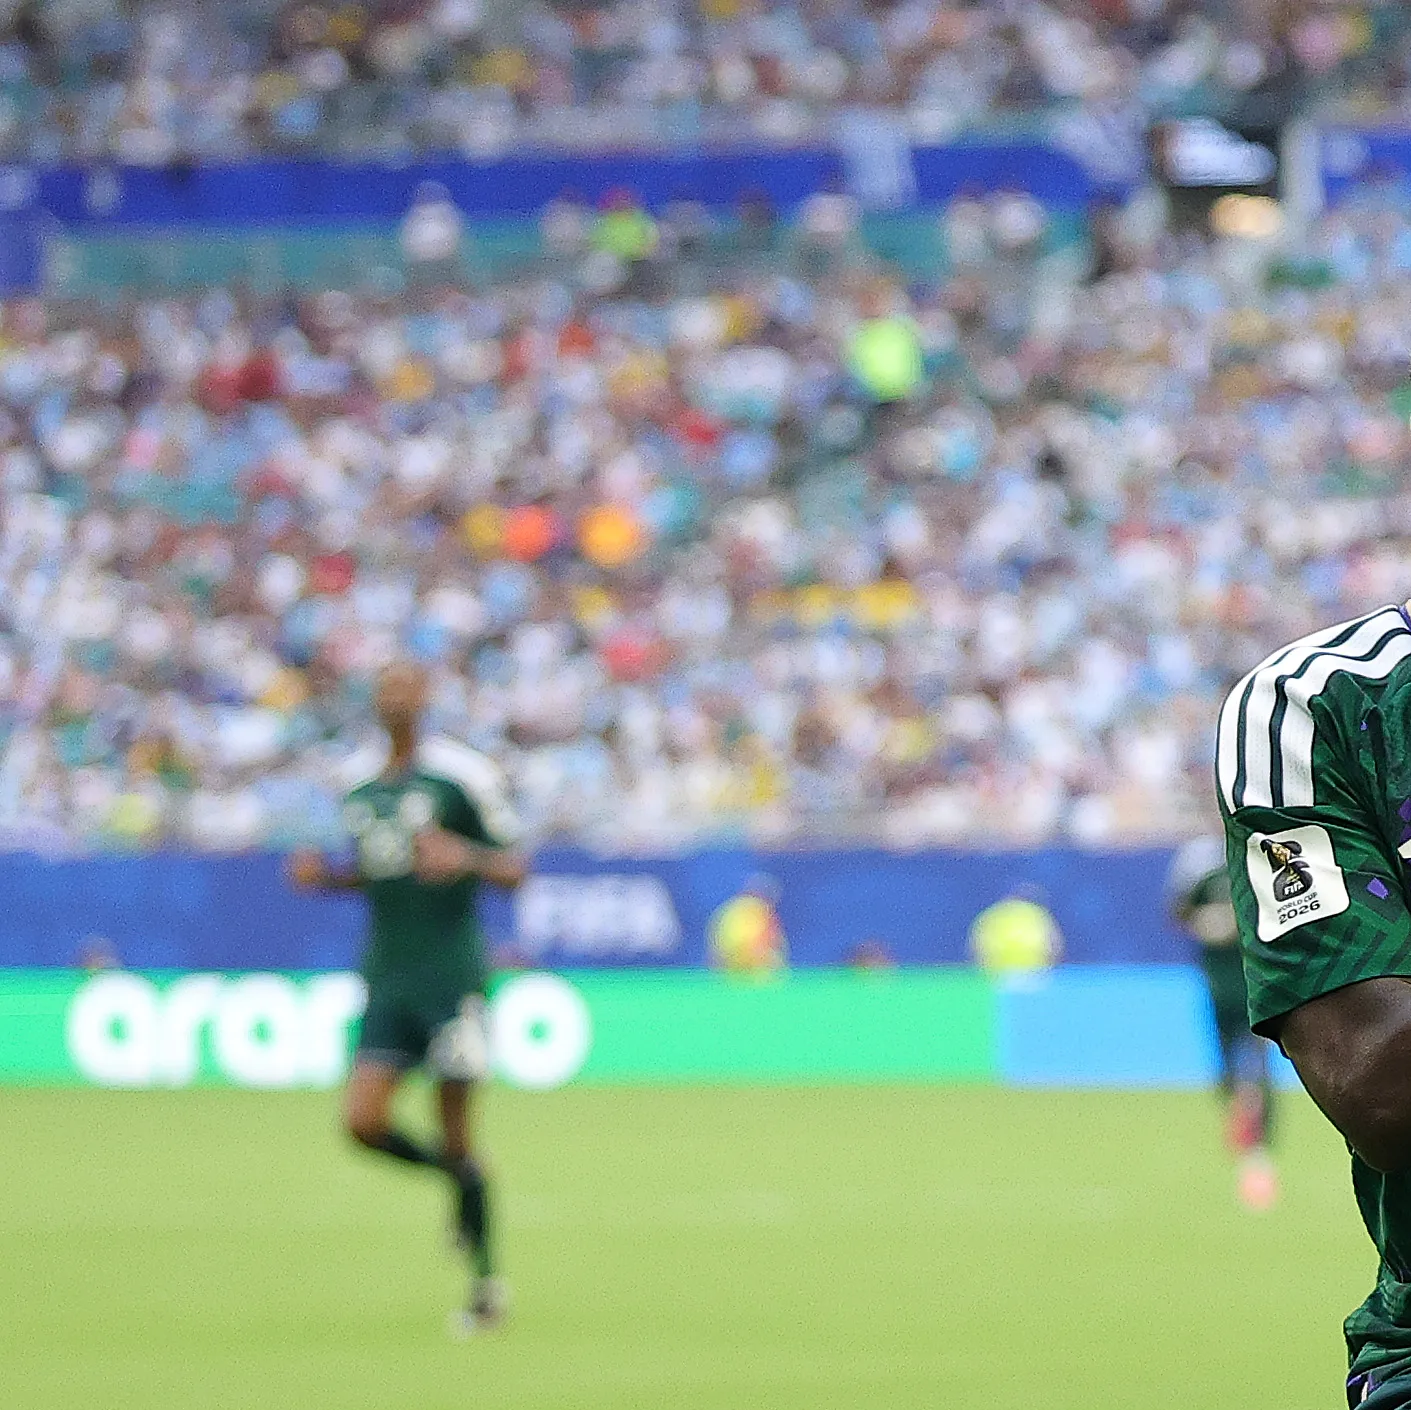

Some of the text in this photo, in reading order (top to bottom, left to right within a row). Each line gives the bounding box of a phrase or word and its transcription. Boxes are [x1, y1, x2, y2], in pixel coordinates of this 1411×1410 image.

[1283, 882, 1305, 896] FIFA
[1277, 892, 1318, 915] WORLD CUP
[1278, 900, 1321, 925] 2026
[68, 970, 590, 1088] arao
